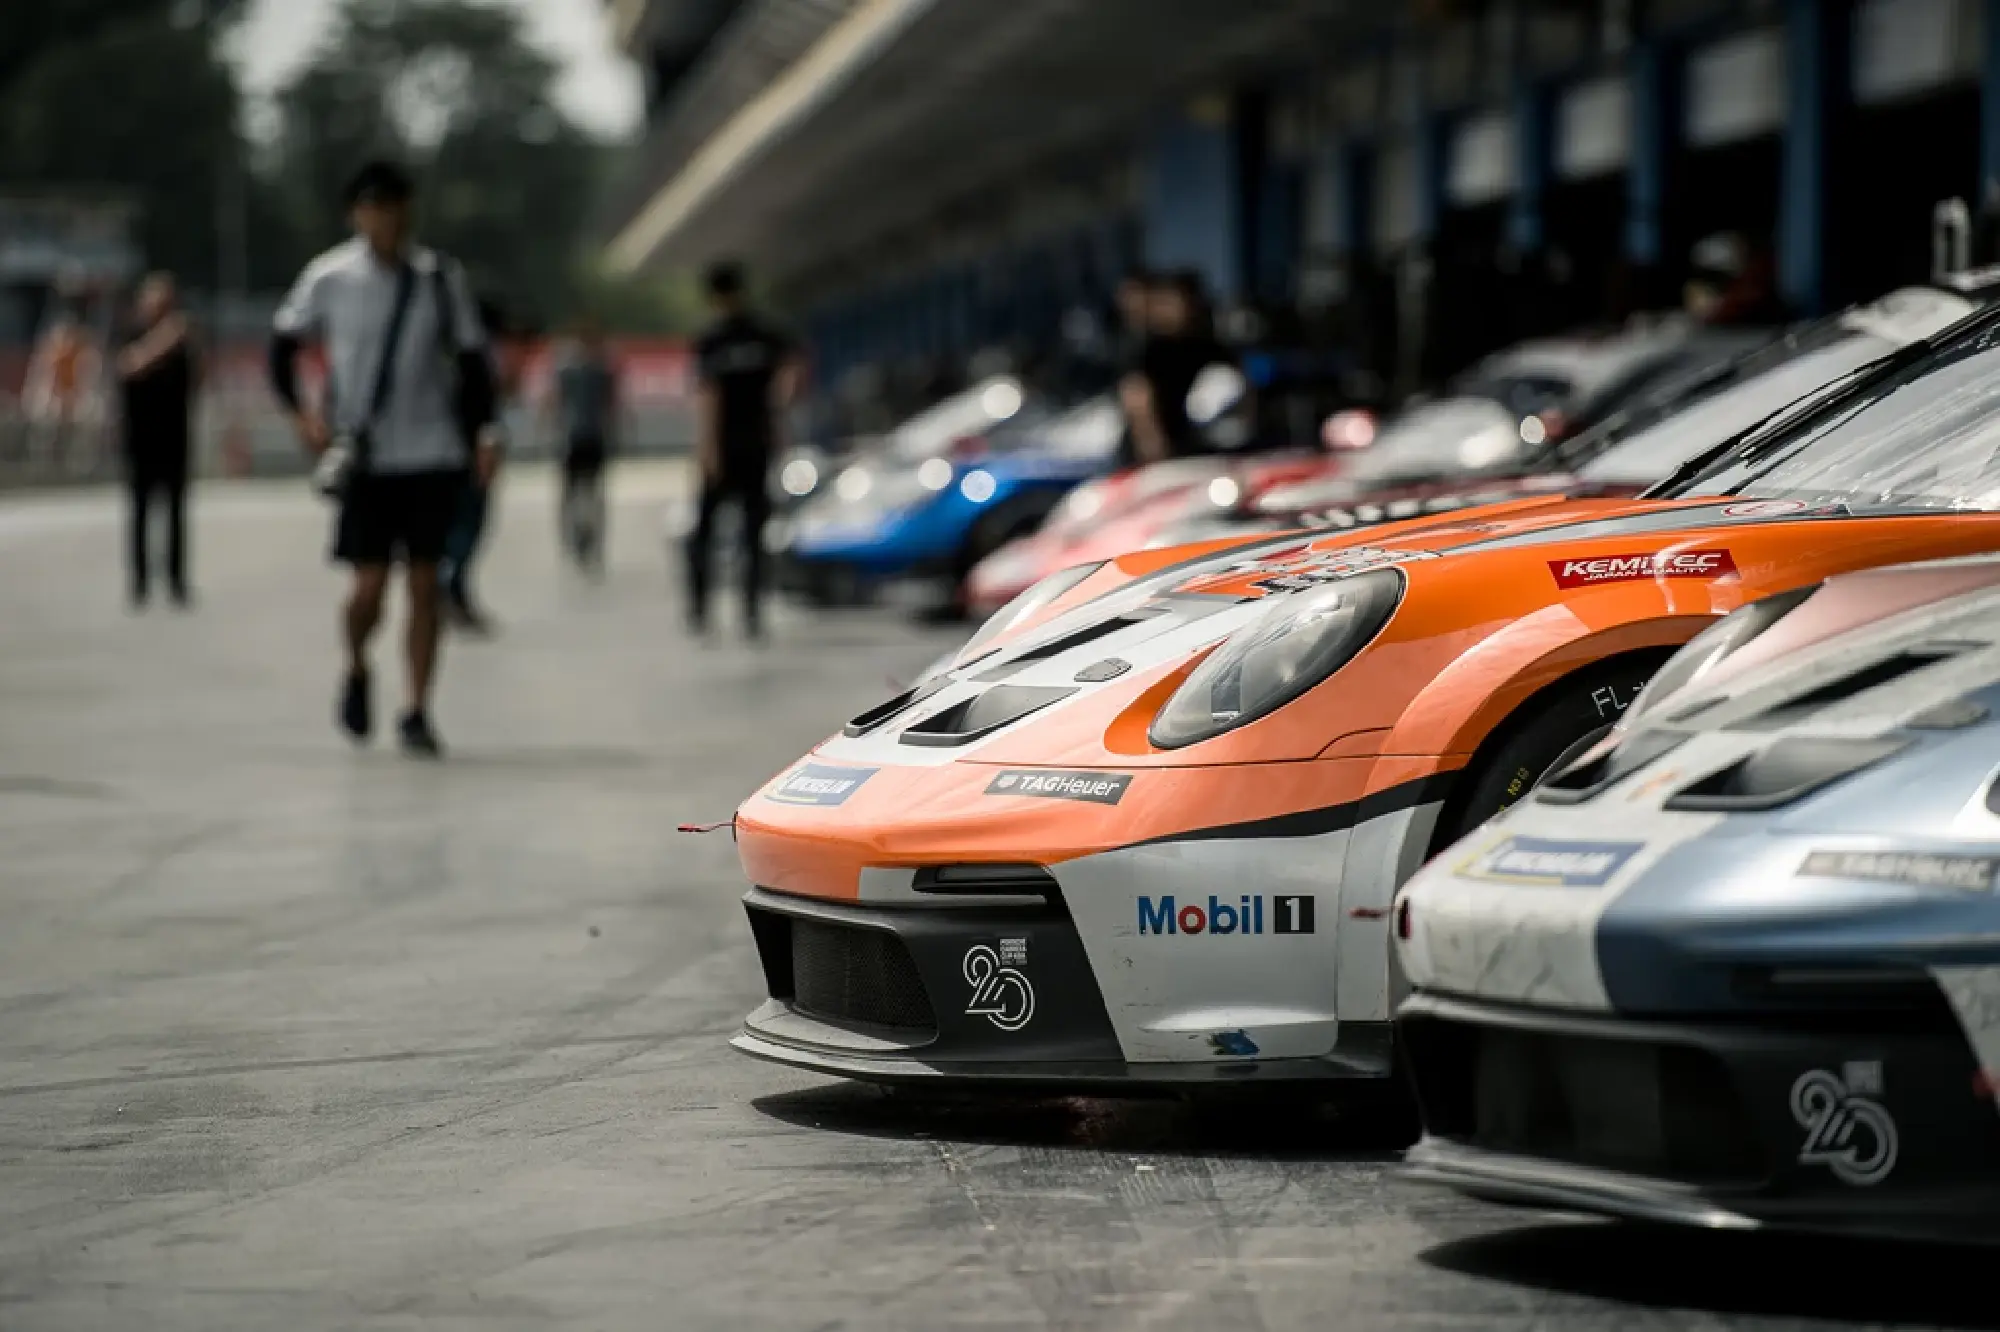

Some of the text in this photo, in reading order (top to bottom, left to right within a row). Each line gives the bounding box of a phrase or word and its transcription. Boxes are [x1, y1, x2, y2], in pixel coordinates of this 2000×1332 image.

[1584, 570, 1637, 581] JAPAN
[1591, 685, 1628, 718] FL
[1137, 895, 1263, 935] Mobil
